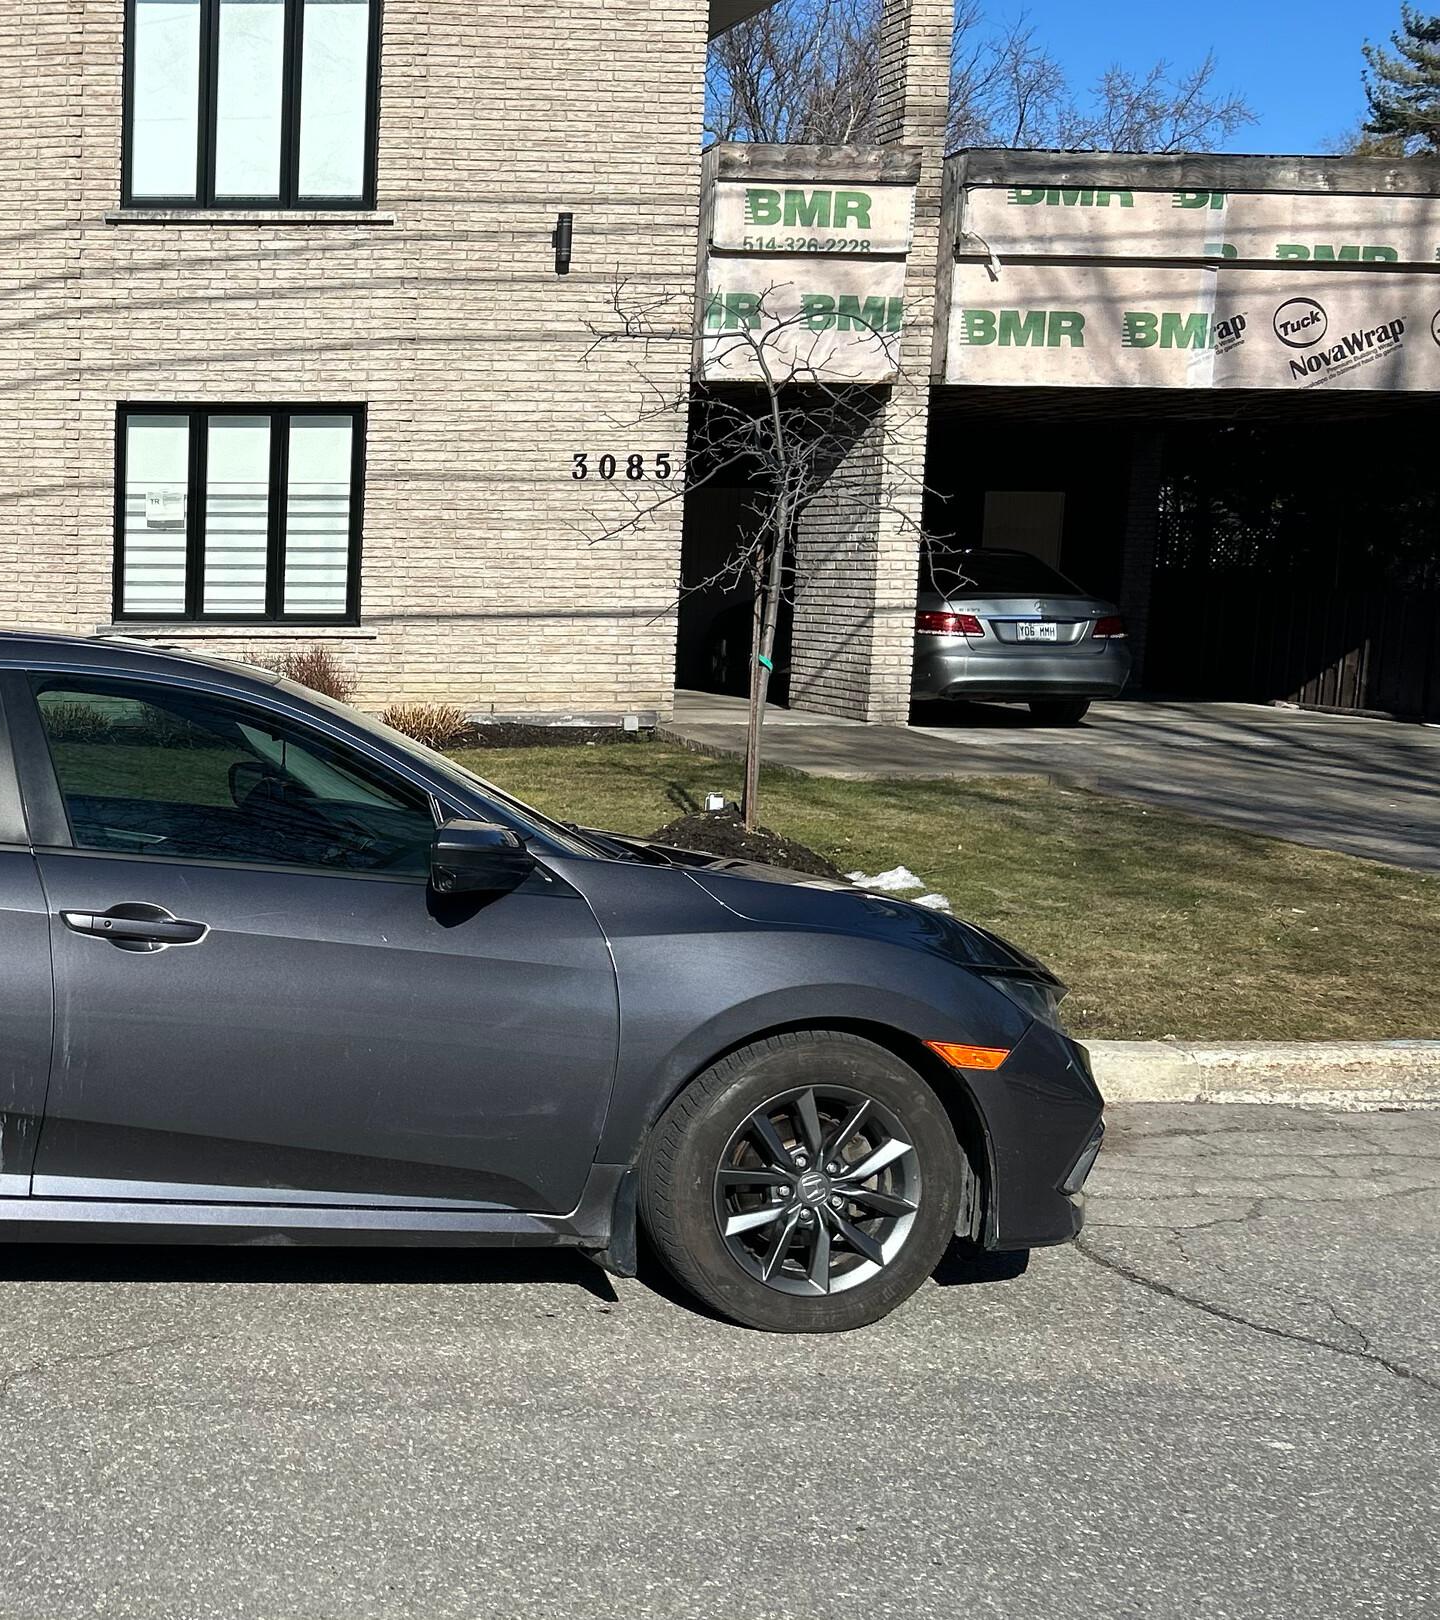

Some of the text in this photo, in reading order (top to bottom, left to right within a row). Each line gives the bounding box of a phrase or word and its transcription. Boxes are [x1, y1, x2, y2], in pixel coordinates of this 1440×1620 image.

[744, 188, 872, 229] BMR
[742, 236, 872, 252] 514-326-2228
[960, 309, 1085, 347] BMR
[1279, 311, 1321, 336] Tuck
[1289, 318, 1405, 380] NovaWrap
[572, 453, 671, 480] 3085
